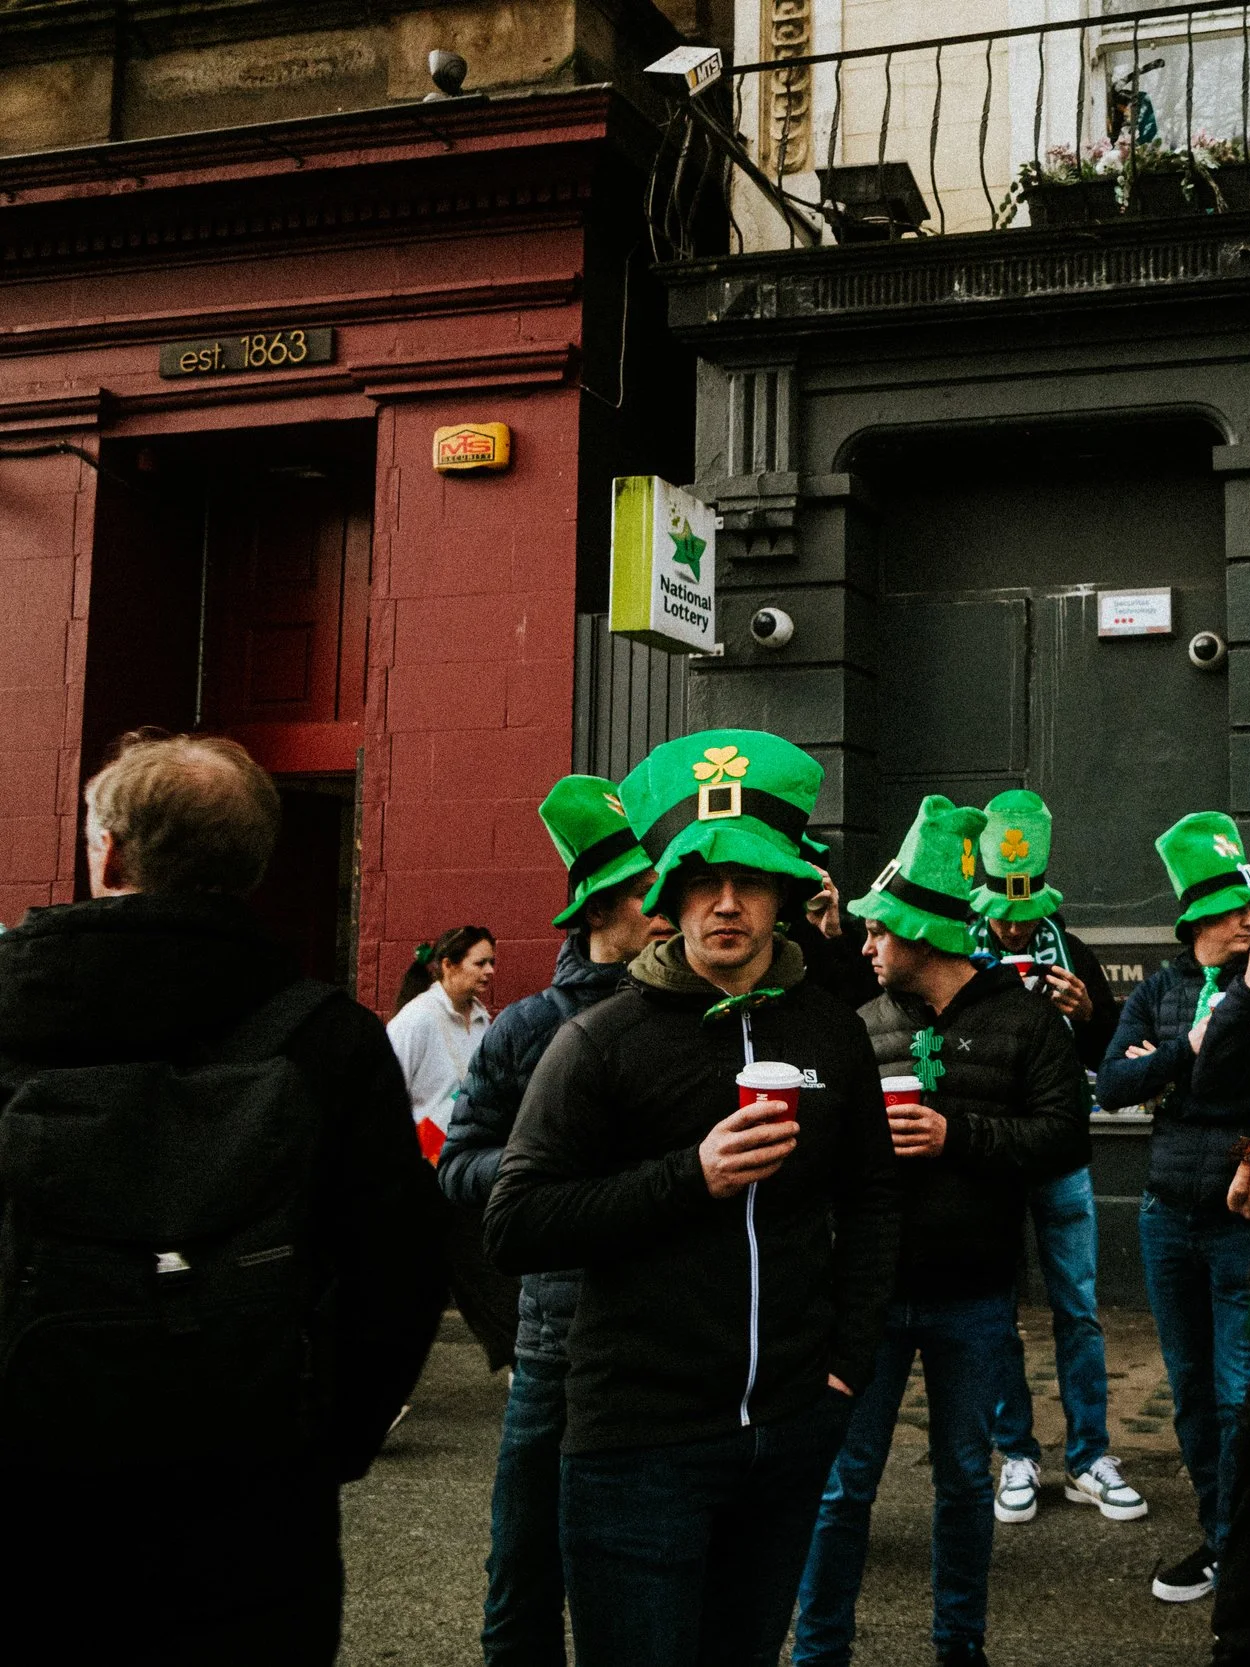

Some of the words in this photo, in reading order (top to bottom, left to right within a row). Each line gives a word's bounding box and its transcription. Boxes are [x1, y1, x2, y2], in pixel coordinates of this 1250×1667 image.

[695, 52, 720, 86] MTS
[179, 342, 226, 372] est.
[240, 329, 307, 368] 1863
[441, 433, 491, 456] MTS
[660, 573, 712, 612] National
[663, 595, 709, 633] Lottery
